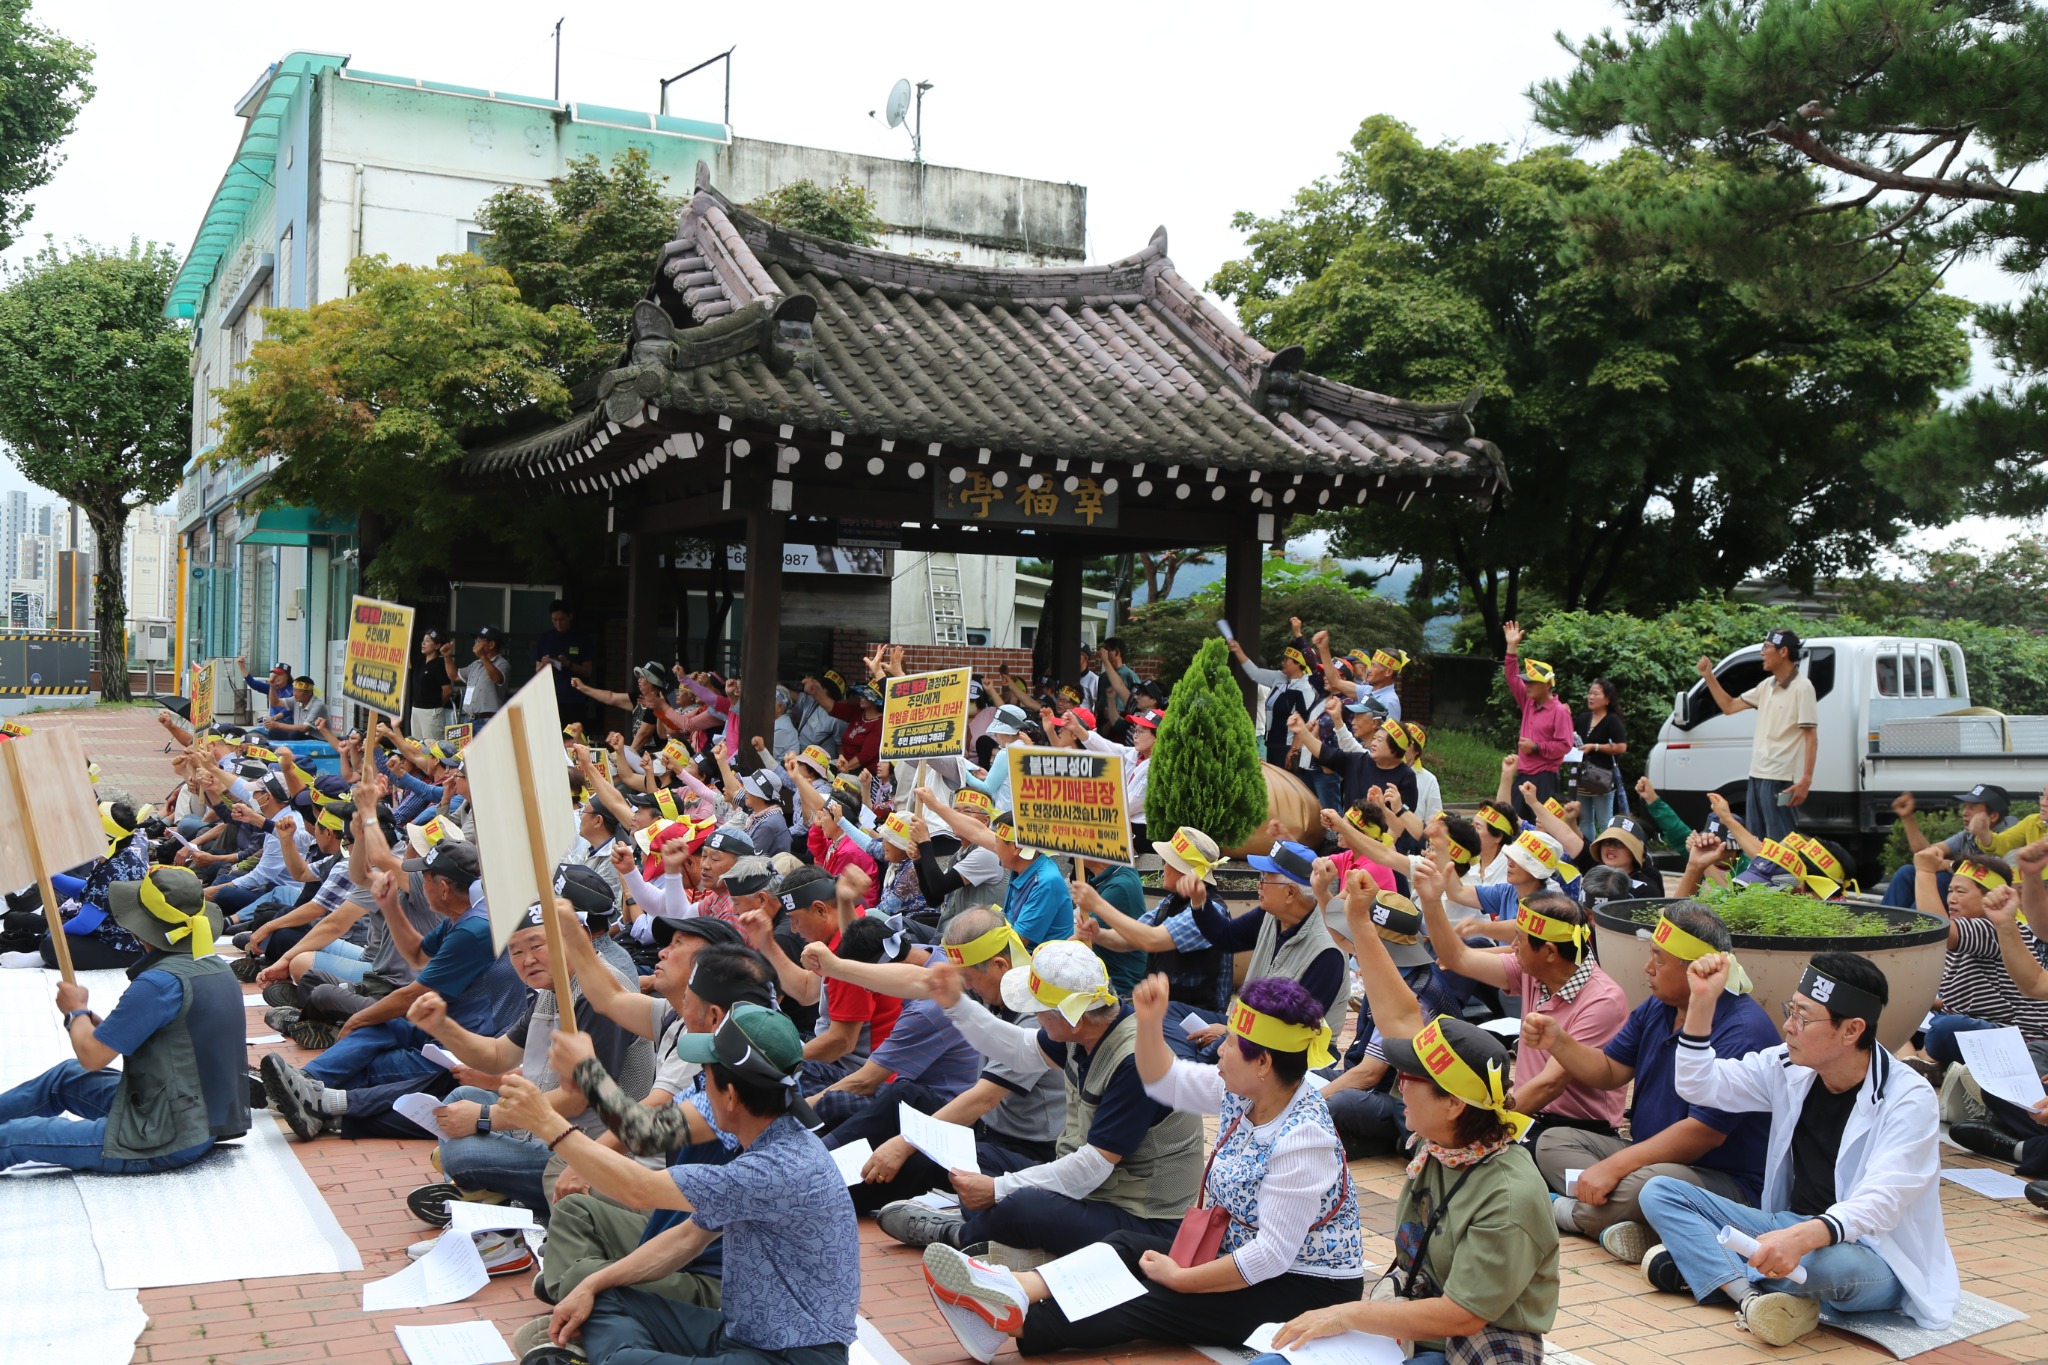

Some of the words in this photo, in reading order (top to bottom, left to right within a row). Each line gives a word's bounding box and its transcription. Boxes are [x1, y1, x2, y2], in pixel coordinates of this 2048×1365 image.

[895, 682, 910, 697] 주민
[907, 690, 941, 708] 주민에게
[888, 709, 910, 726] 책임을
[910, 704, 941, 722] 떠넘기지
[942, 700, 963, 716] 마라!
[1385, 722, 1403, 739] 반대
[1410, 727, 1424, 743] 반대
[898, 737, 909, 747] 주민
[249, 747, 267, 758] 반대
[1029, 755, 1094, 778] 불법투성이
[956, 791, 989, 809] 사반대
[1020, 777, 1116, 806] 쓰레기매립장
[1019, 802, 1030, 817] 또
[1033, 804, 1119, 823] 연장하시겠습니까?
[1479, 806, 1500, 824] 반대
[886, 816, 904, 833] 반대
[710, 833, 725, 849] 쟁
[780, 893, 796, 911] 쟁
[1372, 903, 1391, 926] 쟁
[1416, 1023, 1456, 1076] 반대
